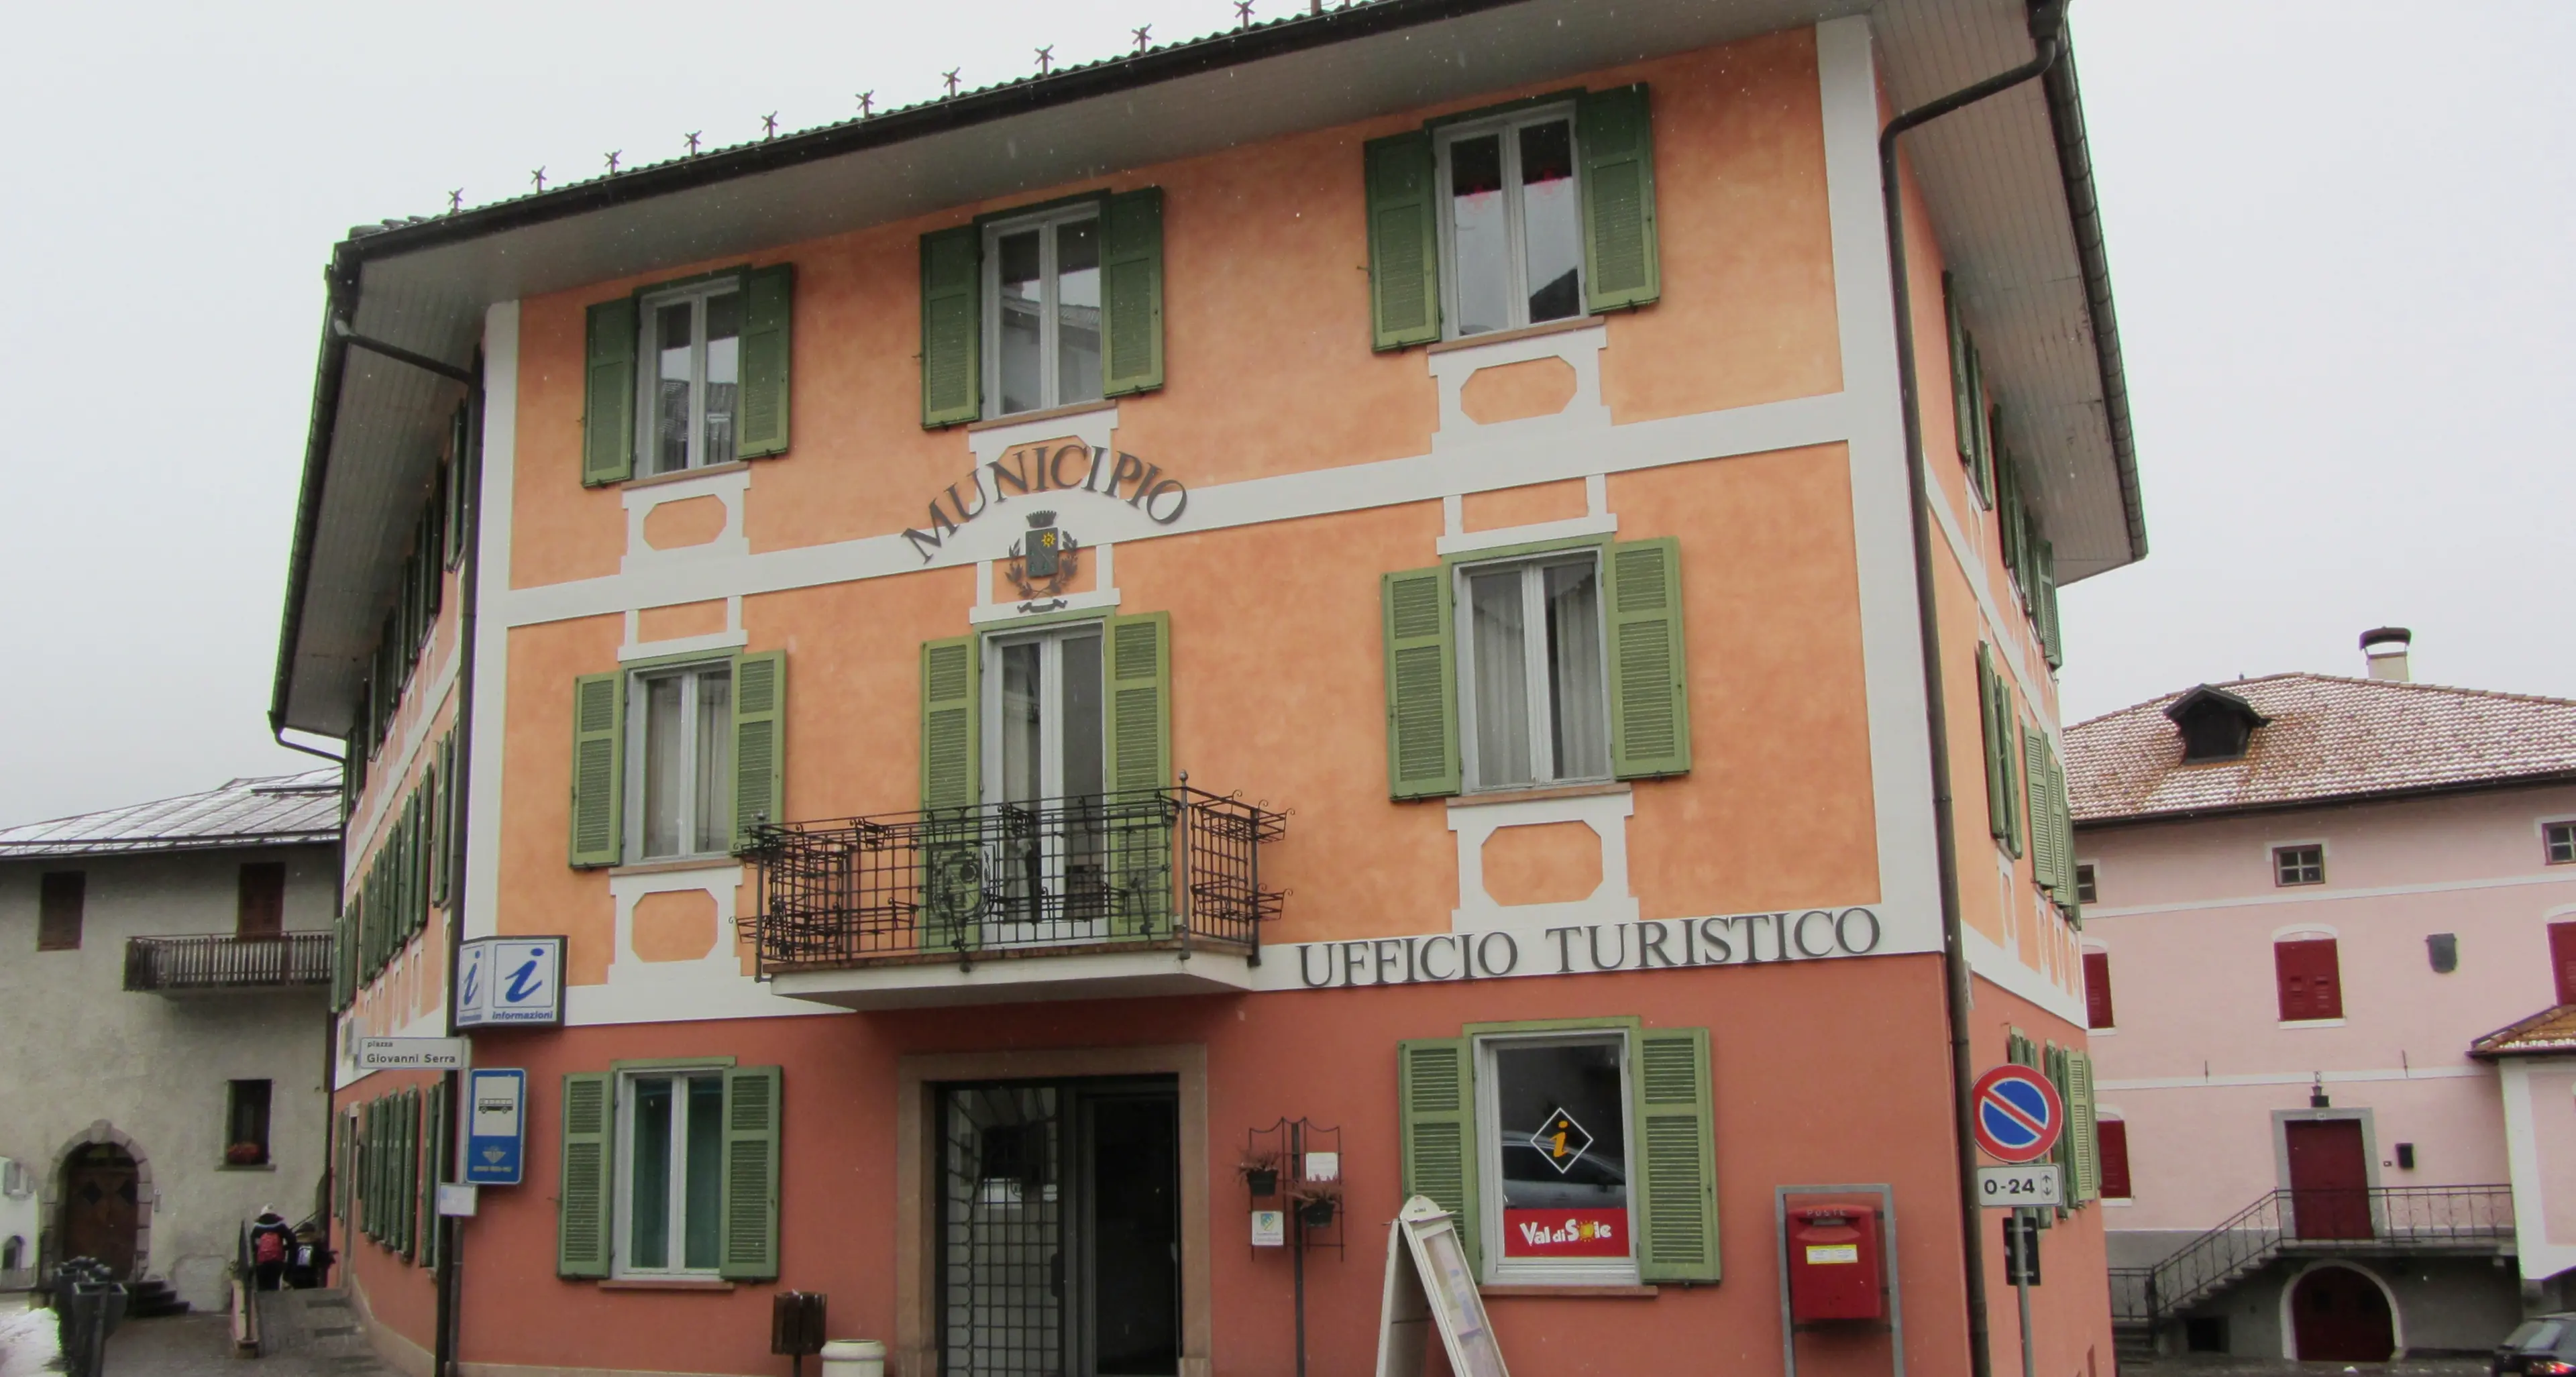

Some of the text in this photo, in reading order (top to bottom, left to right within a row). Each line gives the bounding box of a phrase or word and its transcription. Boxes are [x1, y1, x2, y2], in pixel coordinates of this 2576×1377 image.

[901, 445, 1187, 564] MUNICIPIO
[1297, 907, 1880, 989] UFFICIO TURISTICO
[504, 948, 545, 1002] i
[492, 1011, 553, 1020] informazioni
[367, 1054, 456, 1063] Giovanni Serra
[1984, 1178, 2035, 1195] 0-24
[1519, 1218, 1611, 1246] Val di Sole
